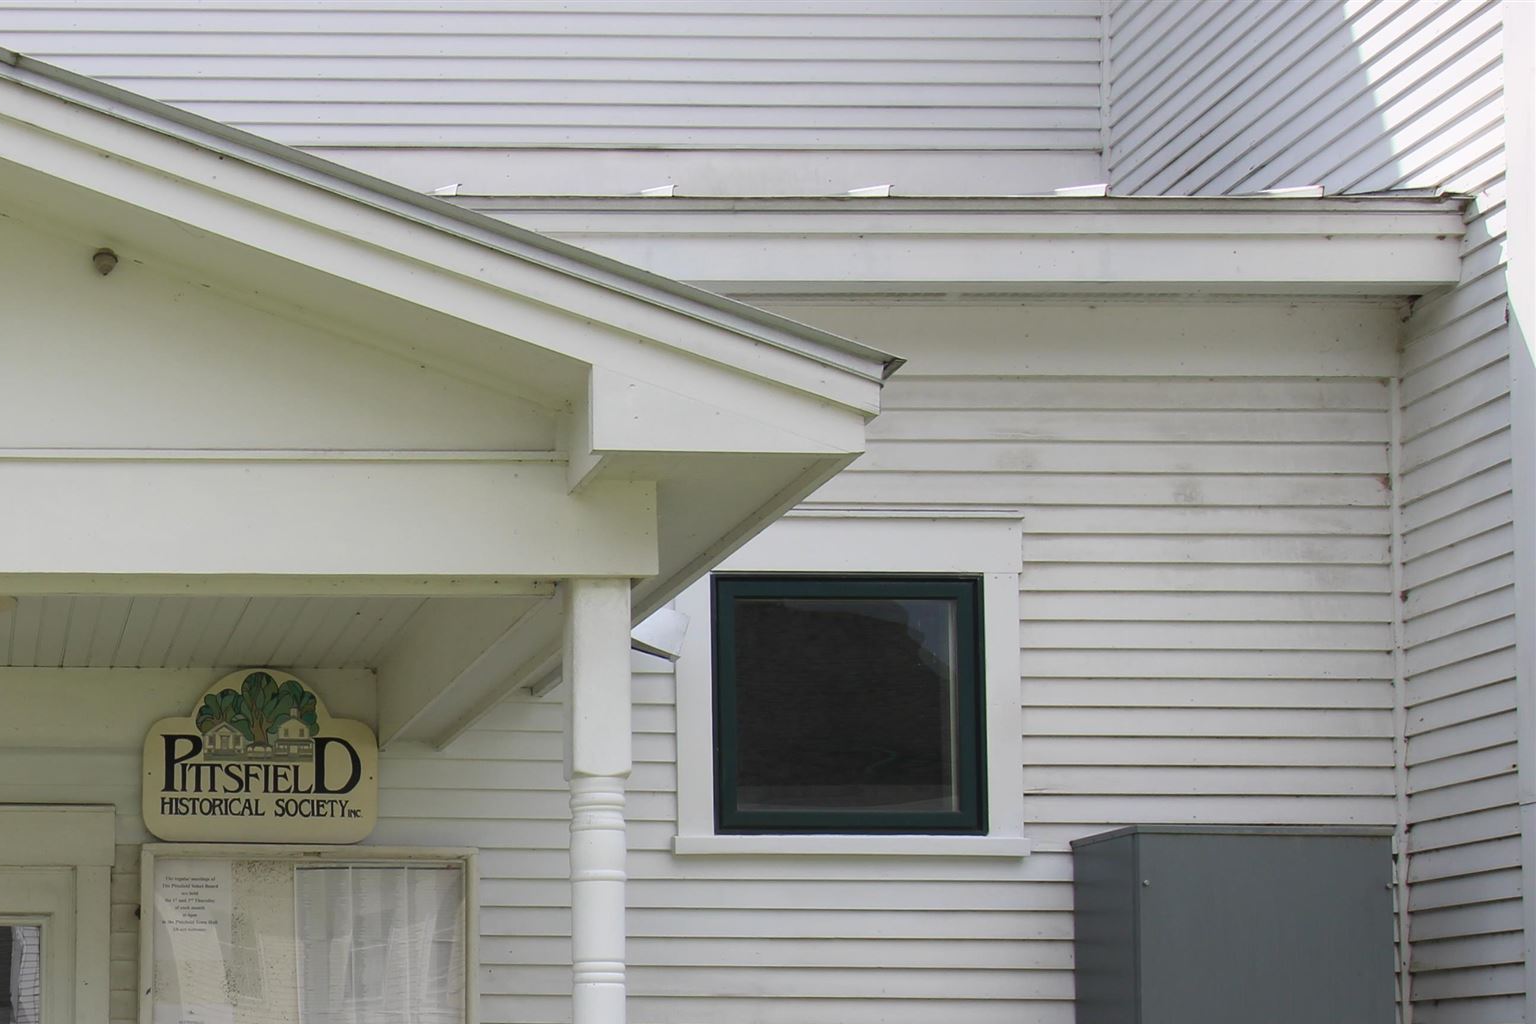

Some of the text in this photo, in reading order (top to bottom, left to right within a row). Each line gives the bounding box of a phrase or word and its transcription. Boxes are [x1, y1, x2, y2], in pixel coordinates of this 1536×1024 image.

[161, 733, 362, 795] PITTSFIELD
[160, 797, 265, 817] HISTORICAL
[274, 798, 349, 818] SOCIETY
